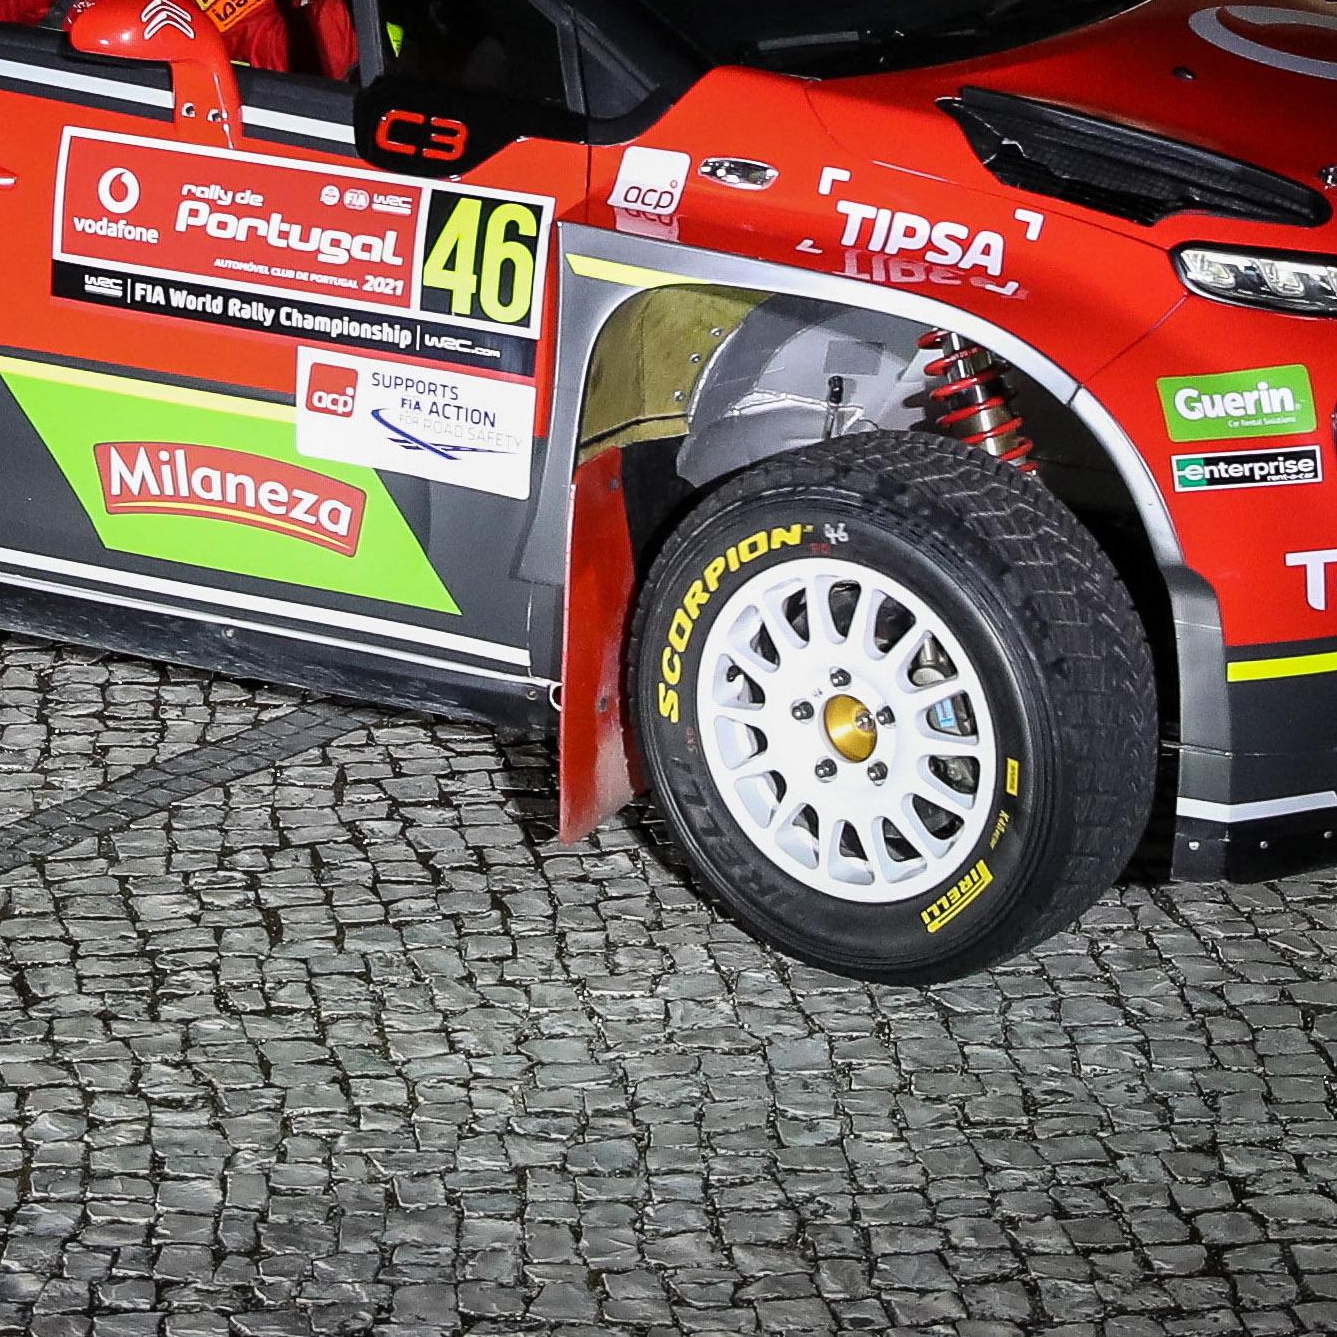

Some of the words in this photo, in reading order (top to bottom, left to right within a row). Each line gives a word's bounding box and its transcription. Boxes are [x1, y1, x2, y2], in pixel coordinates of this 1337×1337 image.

[375, 108, 470, 161] C3
[181, 183, 234, 206] rally
[234, 189, 264, 207] de
[623, 185, 675, 212] acp
[73, 216, 160, 244] vodafone
[174, 199, 404, 266] Portugal
[835, 199, 1005, 277] TIPSA
[422, 197, 538, 324] 46
[270, 266, 295, 279] CLUB
[295, 270, 310, 282] DE
[309, 273, 359, 290] PORTUGAL
[362, 274, 405, 296] 2021
[134, 281, 166, 304] FIA
[168, 287, 224, 315] World
[227, 298, 275, 327] Rally
[279, 308, 413, 350] Championship
[312, 387, 355, 415] acp
[371, 371, 460, 401] SUPPORTS
[1174, 381, 1296, 421] Guerin
[400, 397, 423, 412] FIA
[428, 403, 497, 429] ACTION
[422, 417, 464, 440] ROAD
[467, 426, 523, 450] SAFETY
[1182, 456, 1315, 482] enterprise
[110, 444, 353, 537] Milaneza
[824, 522, 850, 545] 46
[658, 523, 805, 724] SCORPION
[920, 860, 996, 934] PIRELLI
